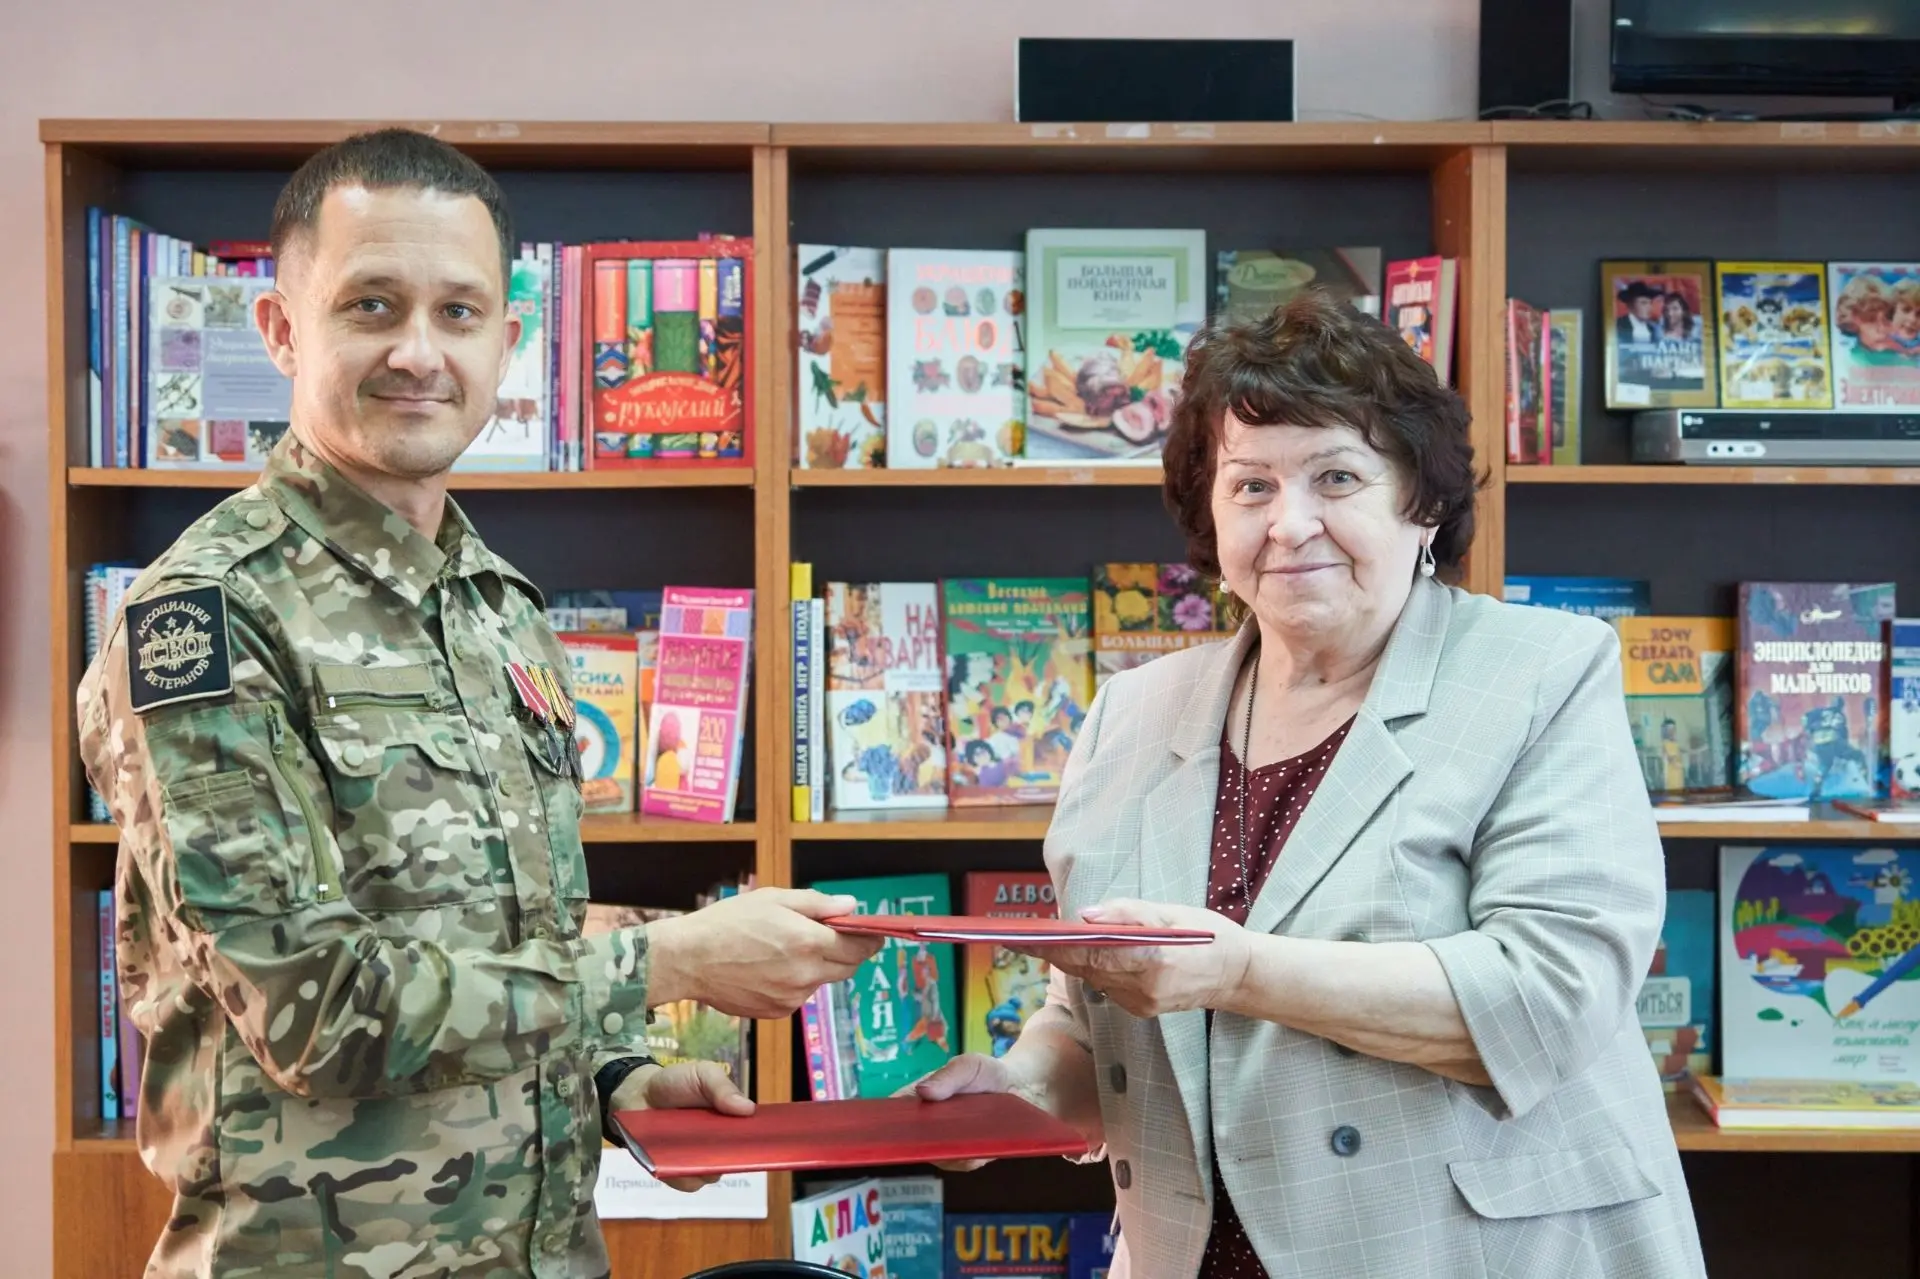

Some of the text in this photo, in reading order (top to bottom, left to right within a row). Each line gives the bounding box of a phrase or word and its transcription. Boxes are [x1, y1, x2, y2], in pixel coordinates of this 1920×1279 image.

[1080, 265, 1154, 277] БОЛЬШАЯ
[1067, 277, 1168, 290] ПОВАРЕННАЯ
[1093, 290, 1142, 302] КНИГА
[137, 600, 212, 638] АССОЦИАЦИЯ
[905, 603, 937, 636] НА
[149, 637, 201, 663] СВО
[796, 646, 808, 657] И
[1101, 634, 1185, 649] БОЛЬШАЯ
[1629, 645, 1696, 660] СДЕЛАТЬ
[144, 658, 210, 690] ВЕТЕРАНОВ
[796, 661, 808, 689] ИГР
[1770, 673, 1873, 694] МАЛЬЧИКОВ
[796, 694, 808, 739] КНИГА
[810, 1187, 881, 1248] АТЛАС
